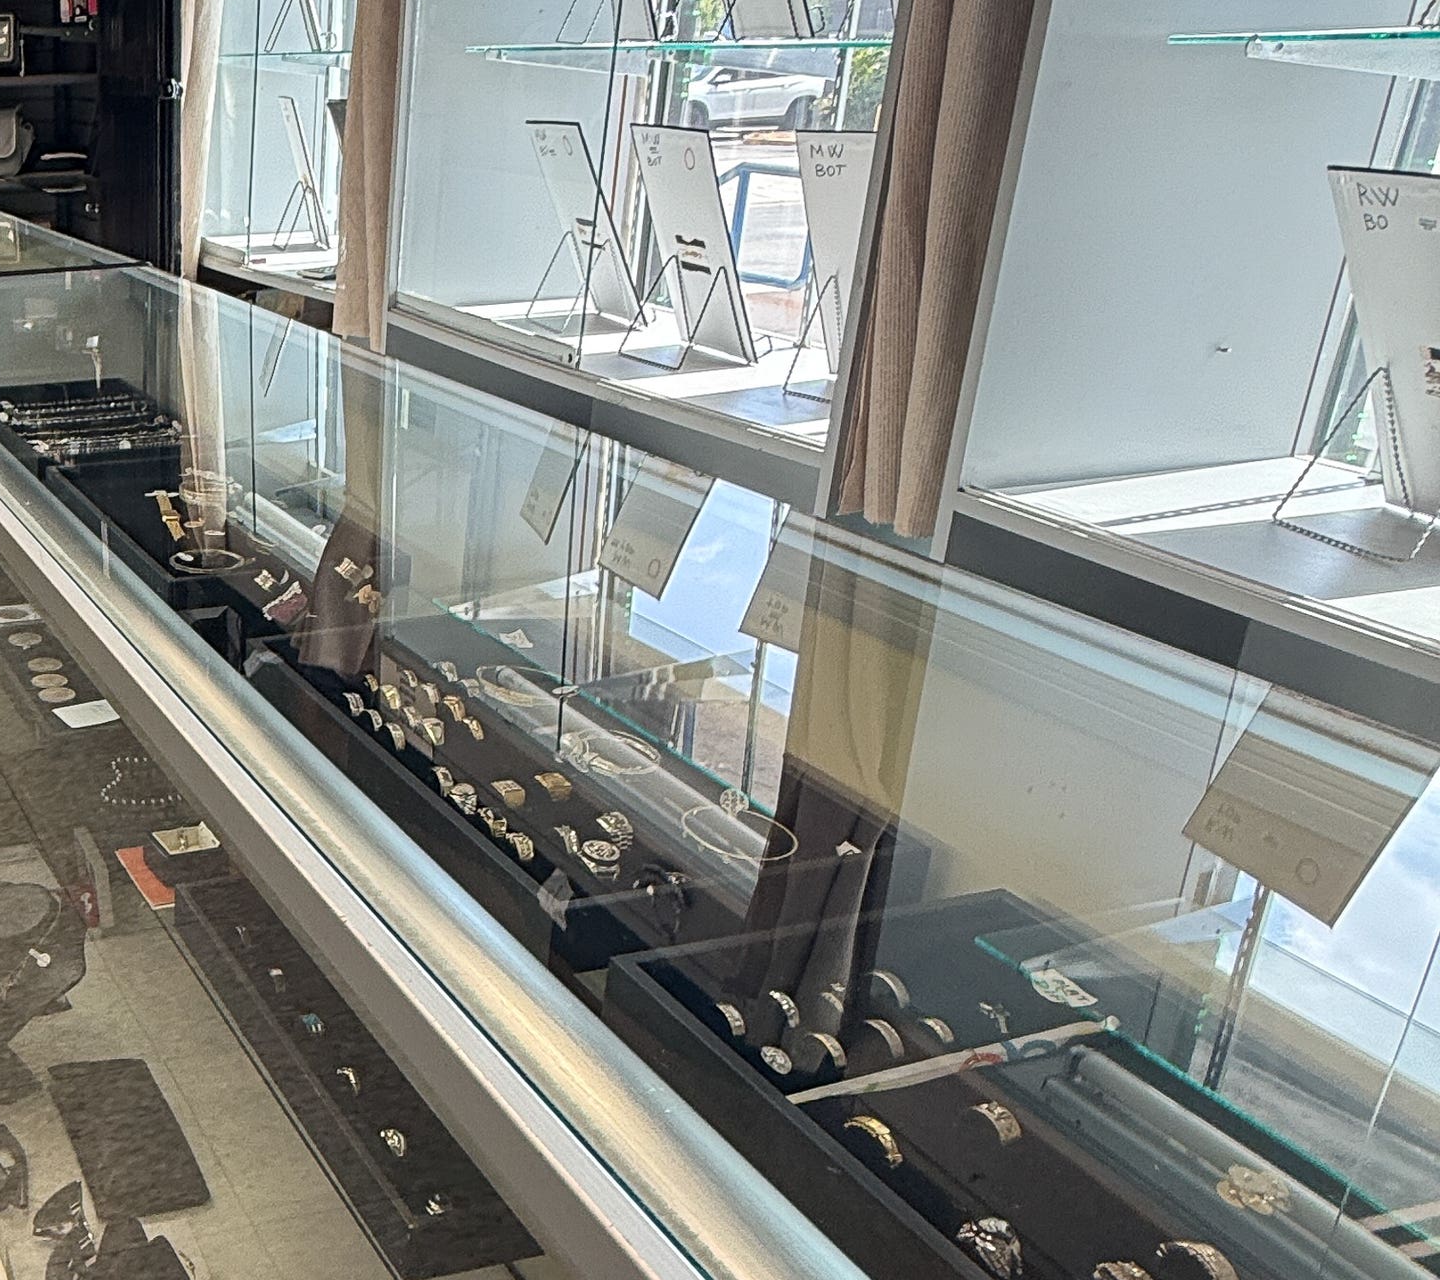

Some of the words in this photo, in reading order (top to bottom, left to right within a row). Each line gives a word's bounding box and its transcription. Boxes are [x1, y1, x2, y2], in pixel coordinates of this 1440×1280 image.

[809, 143, 844, 159] MW
[815, 163, 847, 178] BOT
[1356, 182, 1400, 208] RW
[1363, 213, 1390, 232] BO
